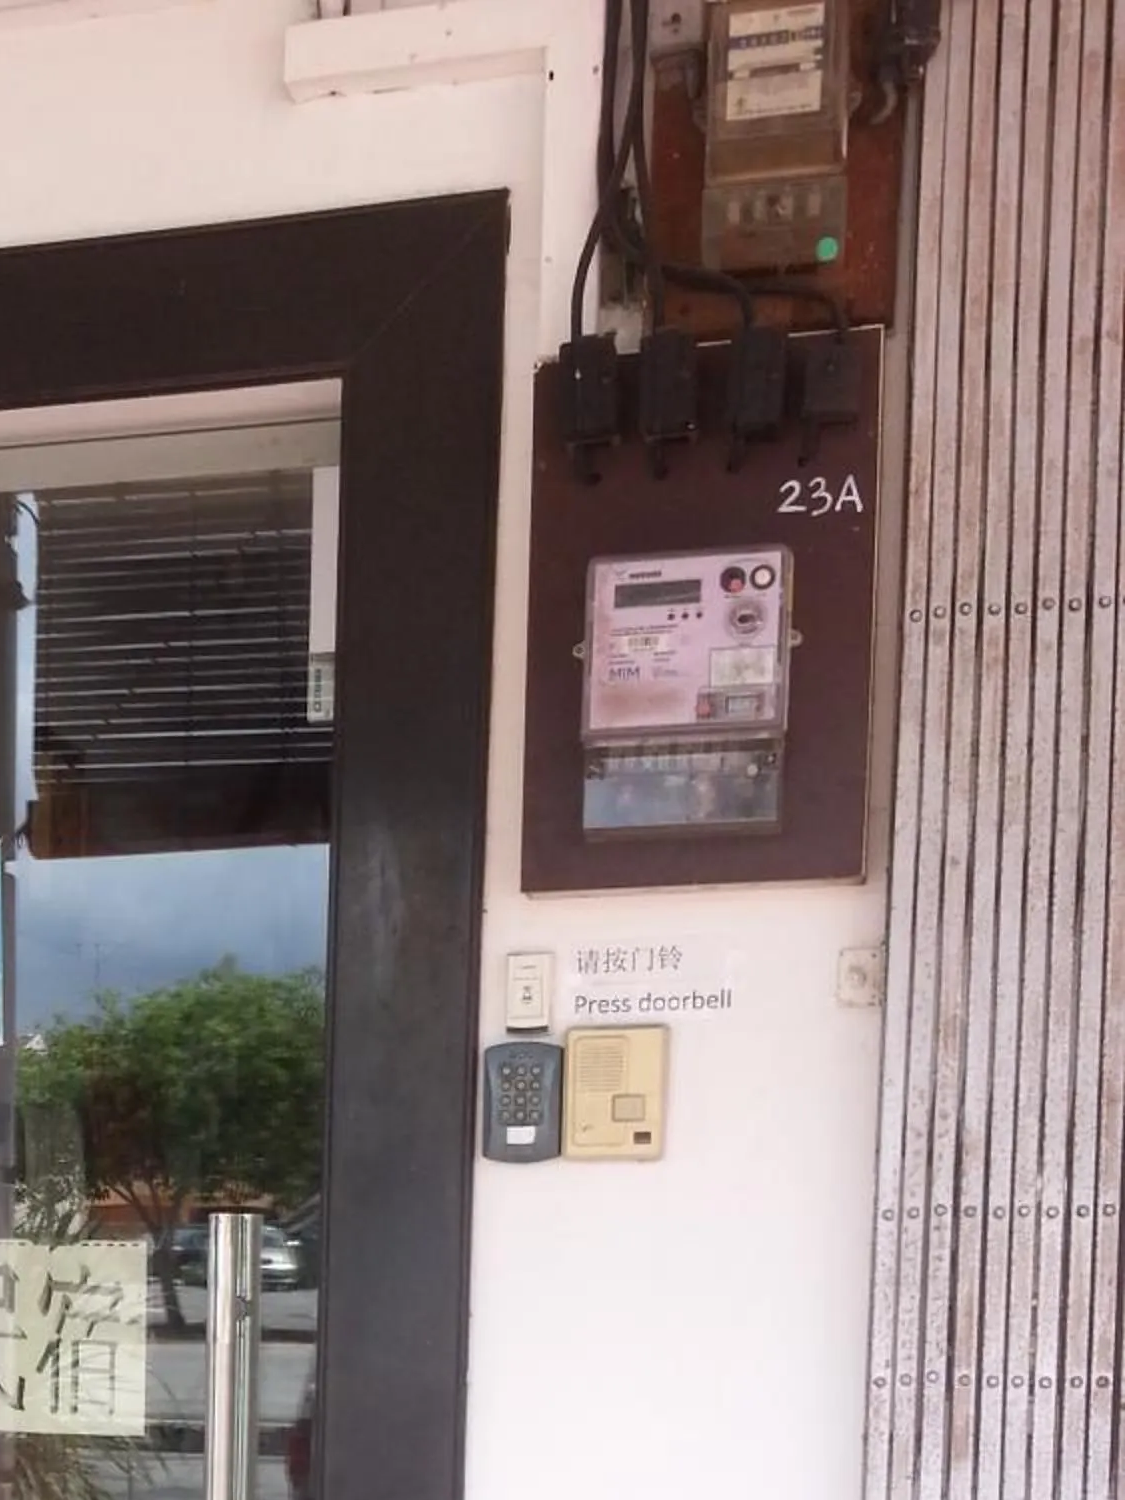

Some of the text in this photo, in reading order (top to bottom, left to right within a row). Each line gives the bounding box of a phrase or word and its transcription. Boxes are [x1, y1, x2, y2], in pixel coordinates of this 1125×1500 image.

[777, 474, 864, 517] 23A
[576, 945, 683, 974] 请按门铃
[574, 988, 733, 1015] Press doorbell
